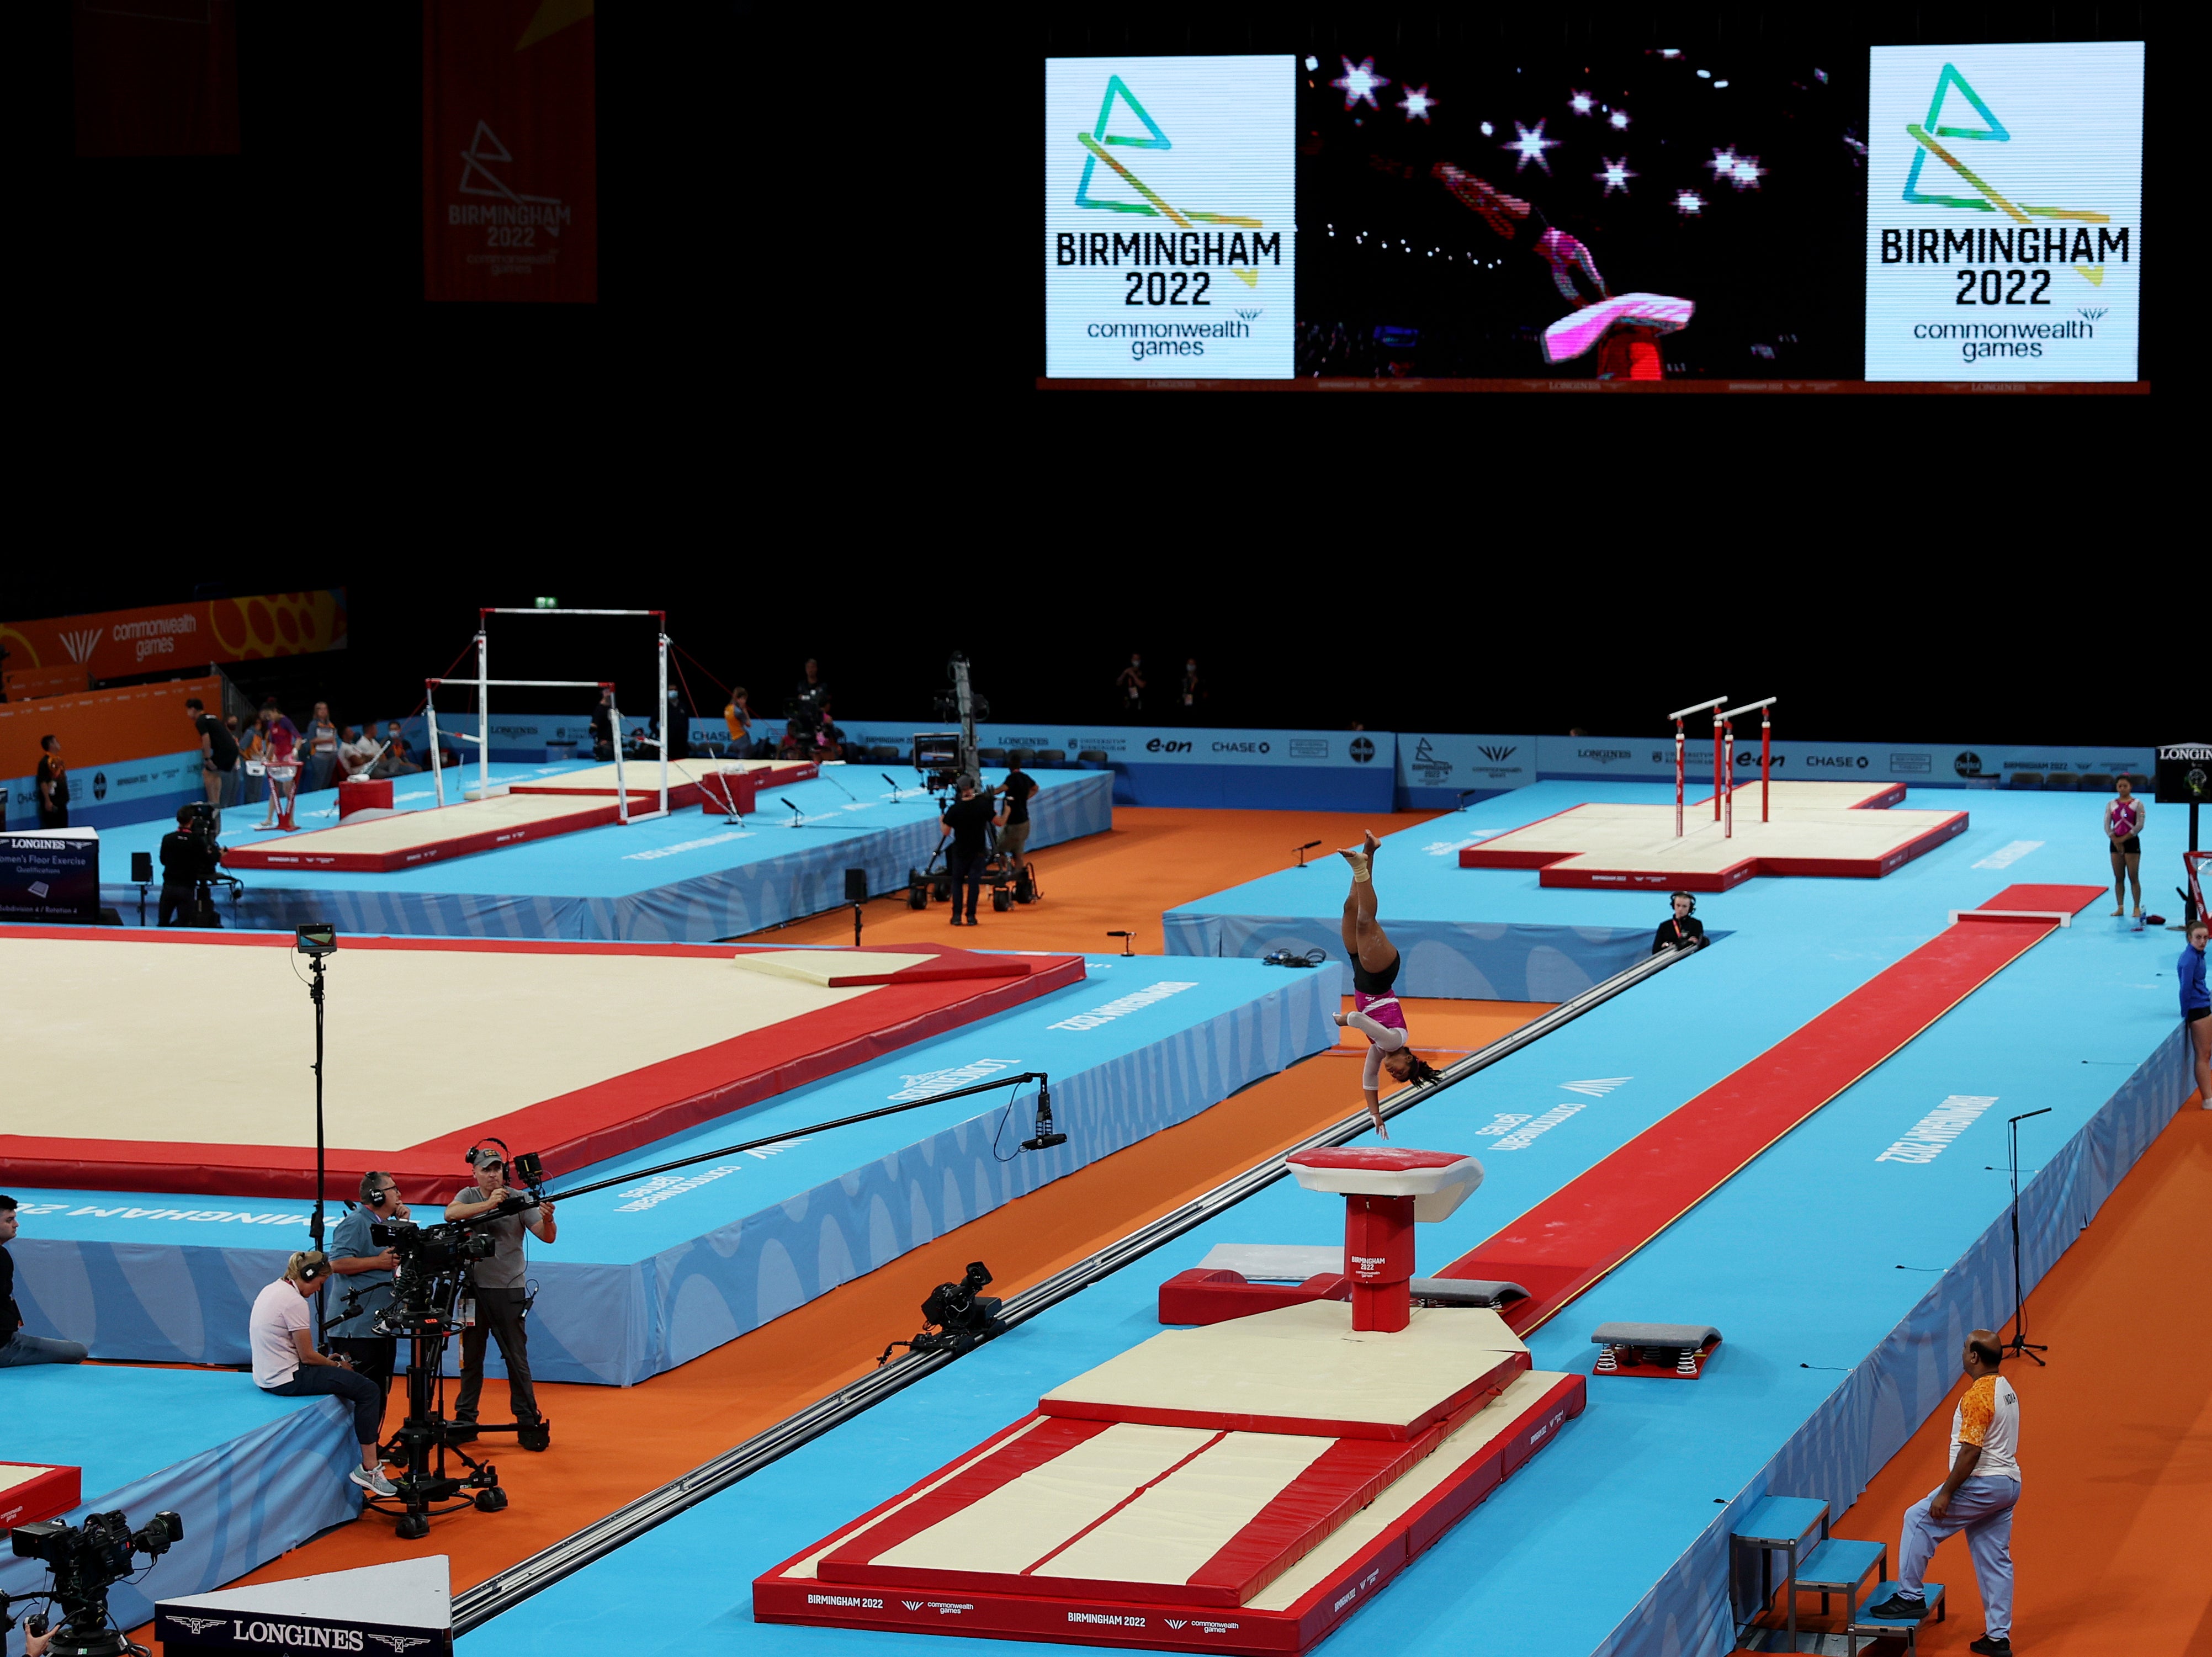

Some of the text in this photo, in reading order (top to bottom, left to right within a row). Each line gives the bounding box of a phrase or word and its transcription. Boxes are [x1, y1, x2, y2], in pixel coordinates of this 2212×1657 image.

[448, 204, 571, 225] BIRMINGHAM
[487, 227, 535, 247] 2022
[1882, 227, 2129, 263] BIRMINGHAM
[1057, 232, 1280, 265] BIRMINGHAM
[1126, 272, 1211, 305] 2022
[1956, 270, 2050, 305] 2022
[1088, 321, 1249, 338] commonwealth
[1914, 320, 2092, 339] commonwealth
[1132, 339, 1204, 360] games
[1963, 341, 2042, 362] games
[113, 613, 197, 642] commonwealth
[136, 636, 174, 662] games
[1212, 742, 1256, 753] CHASE
[1578, 749, 1631, 759] LONGINES
[1806, 756, 1854, 768] CHASE
[12, 838, 65, 849] LONGINES
[29, 854, 50, 864] Floor
[52, 856, 86, 865] Exercise
[1475, 1112, 1533, 1136] games
[1487, 1103, 1587, 1150] commonwealth
[1875, 1095, 1999, 1164] BIRMINGHAM 2022
[1351, 1256, 1385, 1264] BIRMINGHAM
[2003, 1393, 2017, 1406] INDIA
[808, 1594, 883, 1609] BIRMINGHAM 2022
[927, 1601, 974, 1610] commonwealth
[1068, 1612, 1145, 1627] BIRMINGHAM 2022
[1191, 1620, 1239, 1629] commonwealth
[234, 1620, 364, 1652] LONGINES
